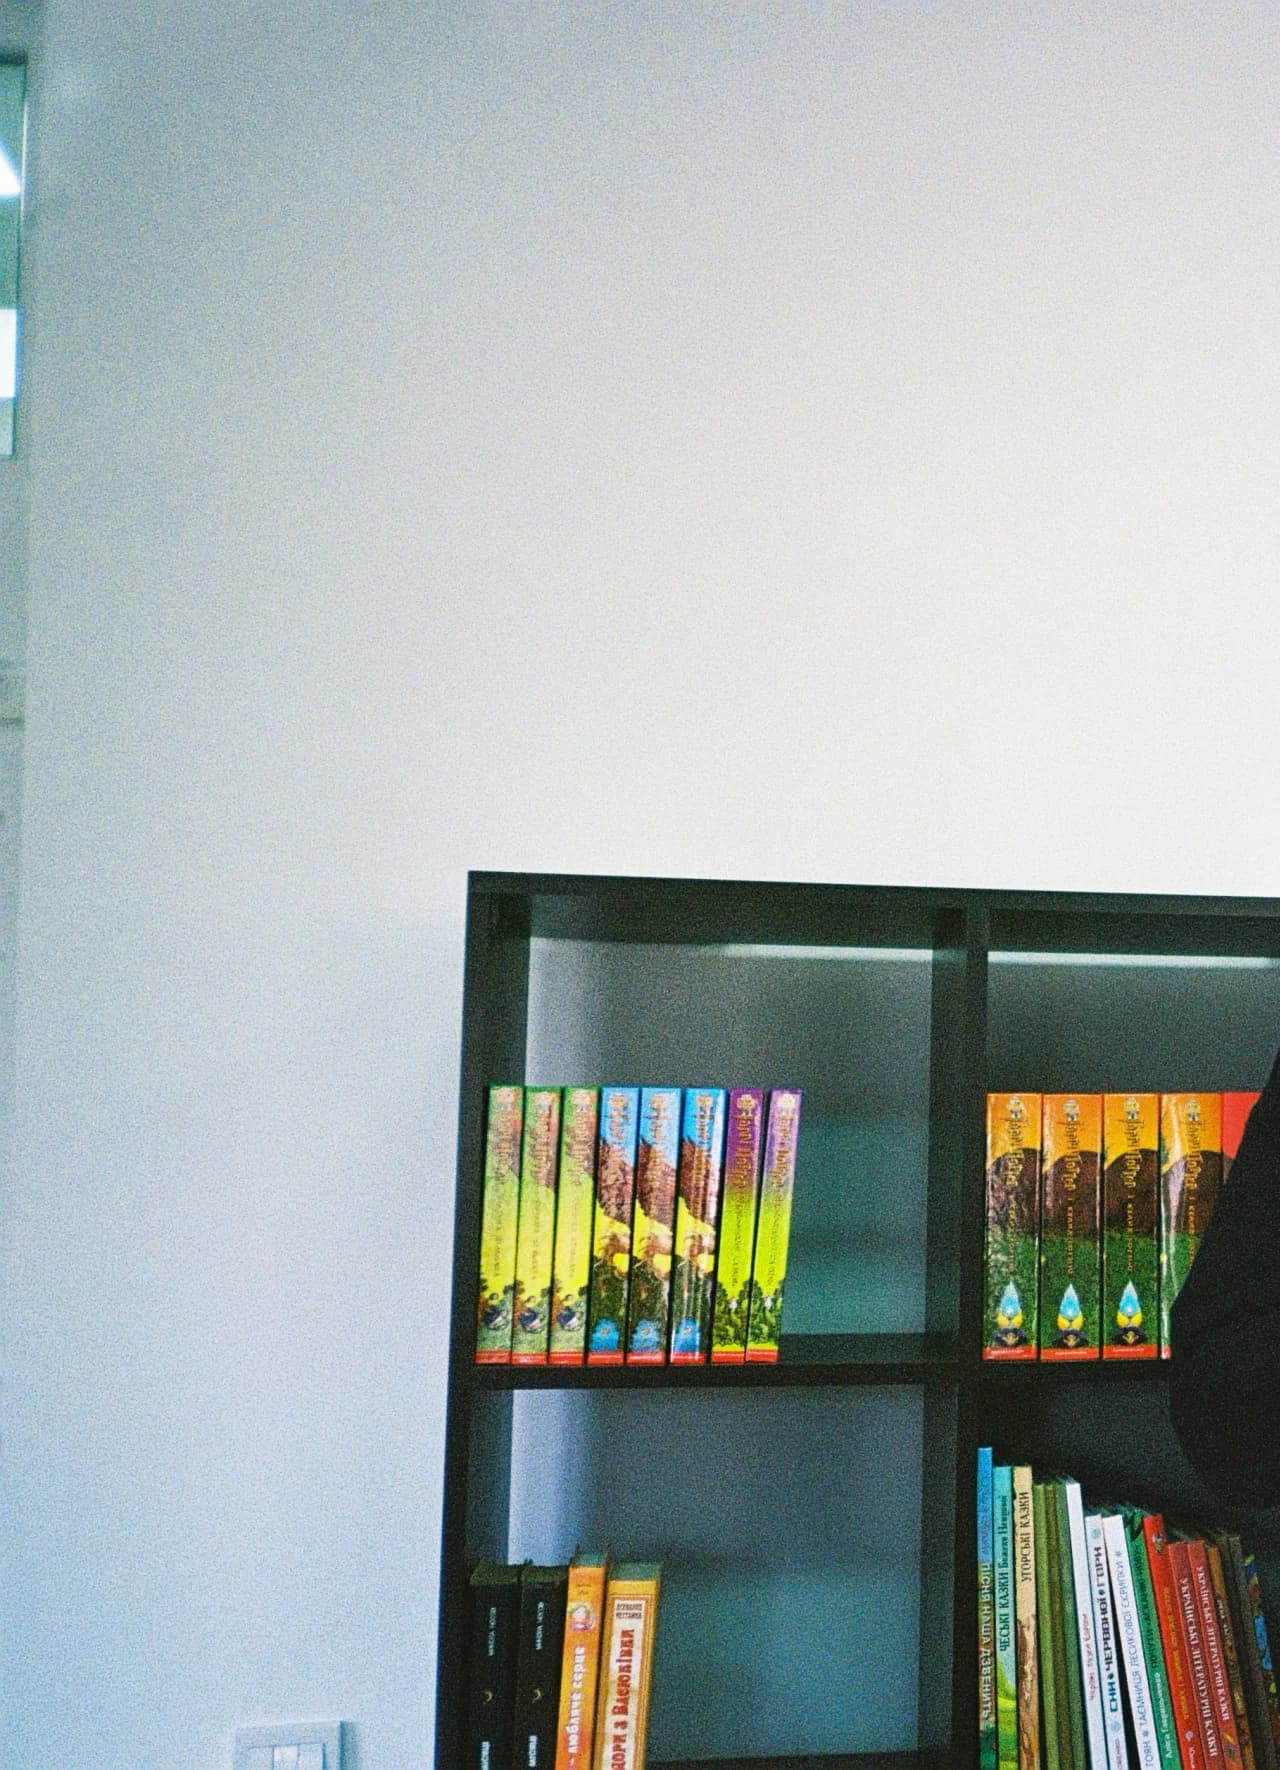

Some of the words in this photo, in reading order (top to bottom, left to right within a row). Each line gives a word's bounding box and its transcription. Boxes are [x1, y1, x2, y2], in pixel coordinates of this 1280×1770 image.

[1018, 1491, 1030, 1528] КАЗКИ
[1019, 1532, 1032, 1581] УГОРСЬКІ
[980, 1562, 990, 1600] ПІСНЯ
[998, 1572, 1009, 1608] КАЗКИ
[1115, 1560, 1129, 1608] СКРИПКИ
[980, 1606, 991, 1644] НАША
[998, 1612, 1010, 1650] ЧЕСЬКІ
[1098, 1596, 1113, 1671] ЧЕРВОНОЇ
[1195, 1565, 1212, 1623] УКРАЇНСЬКІ
[1206, 1624, 1223, 1687] ЛІТЕРАТУРНІ
[1217, 1687, 1229, 1721] КАЗКИ
[980, 1647, 992, 1718] ДЗВЕНИТЬ
[1178, 1577, 1198, 1644] УКРАЇНСЬКІ
[1191, 1646, 1210, 1718] ЛІТЕРАТУРНІ
[1204, 1718, 1217, 1757] КАЗКИ
[1132, 1669, 1147, 1726] ТАЄМНИЦЯ
